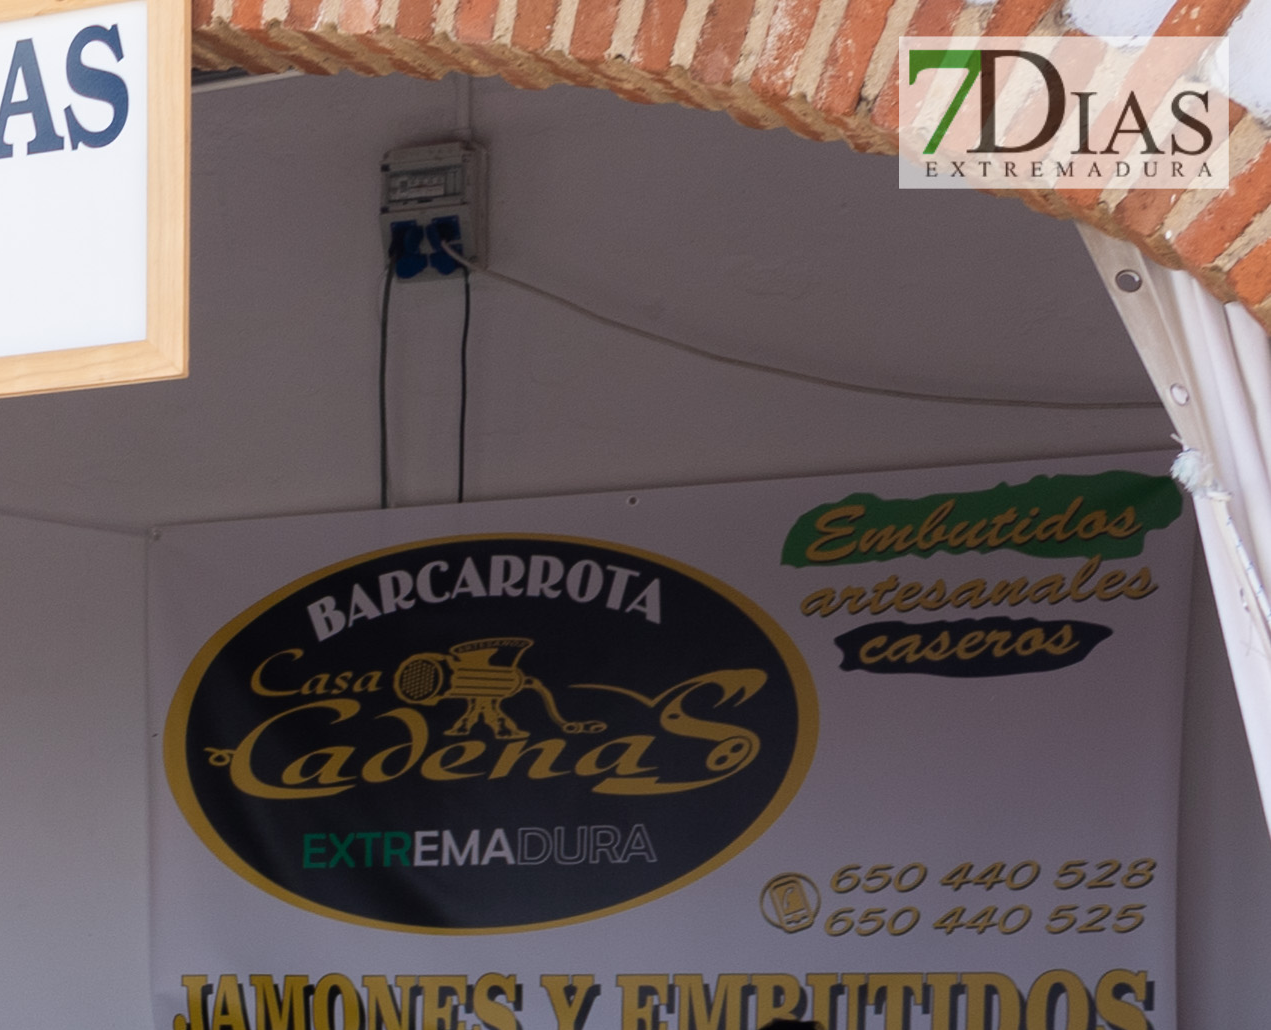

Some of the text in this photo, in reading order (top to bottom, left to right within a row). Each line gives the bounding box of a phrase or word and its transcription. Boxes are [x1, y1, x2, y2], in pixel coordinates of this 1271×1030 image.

[806, 496, 1143, 563] Embutidos
[307, 554, 662, 642] BARCARROTA
[799, 554, 1159, 618] artesanales
[859, 623, 1081, 665] caseros
[250, 648, 383, 697] Casa
[302, 823, 658, 869] EXTREMADURA
[830, 857, 1157, 893] 650 440 528
[824, 902, 1147, 937] 650 440 525
